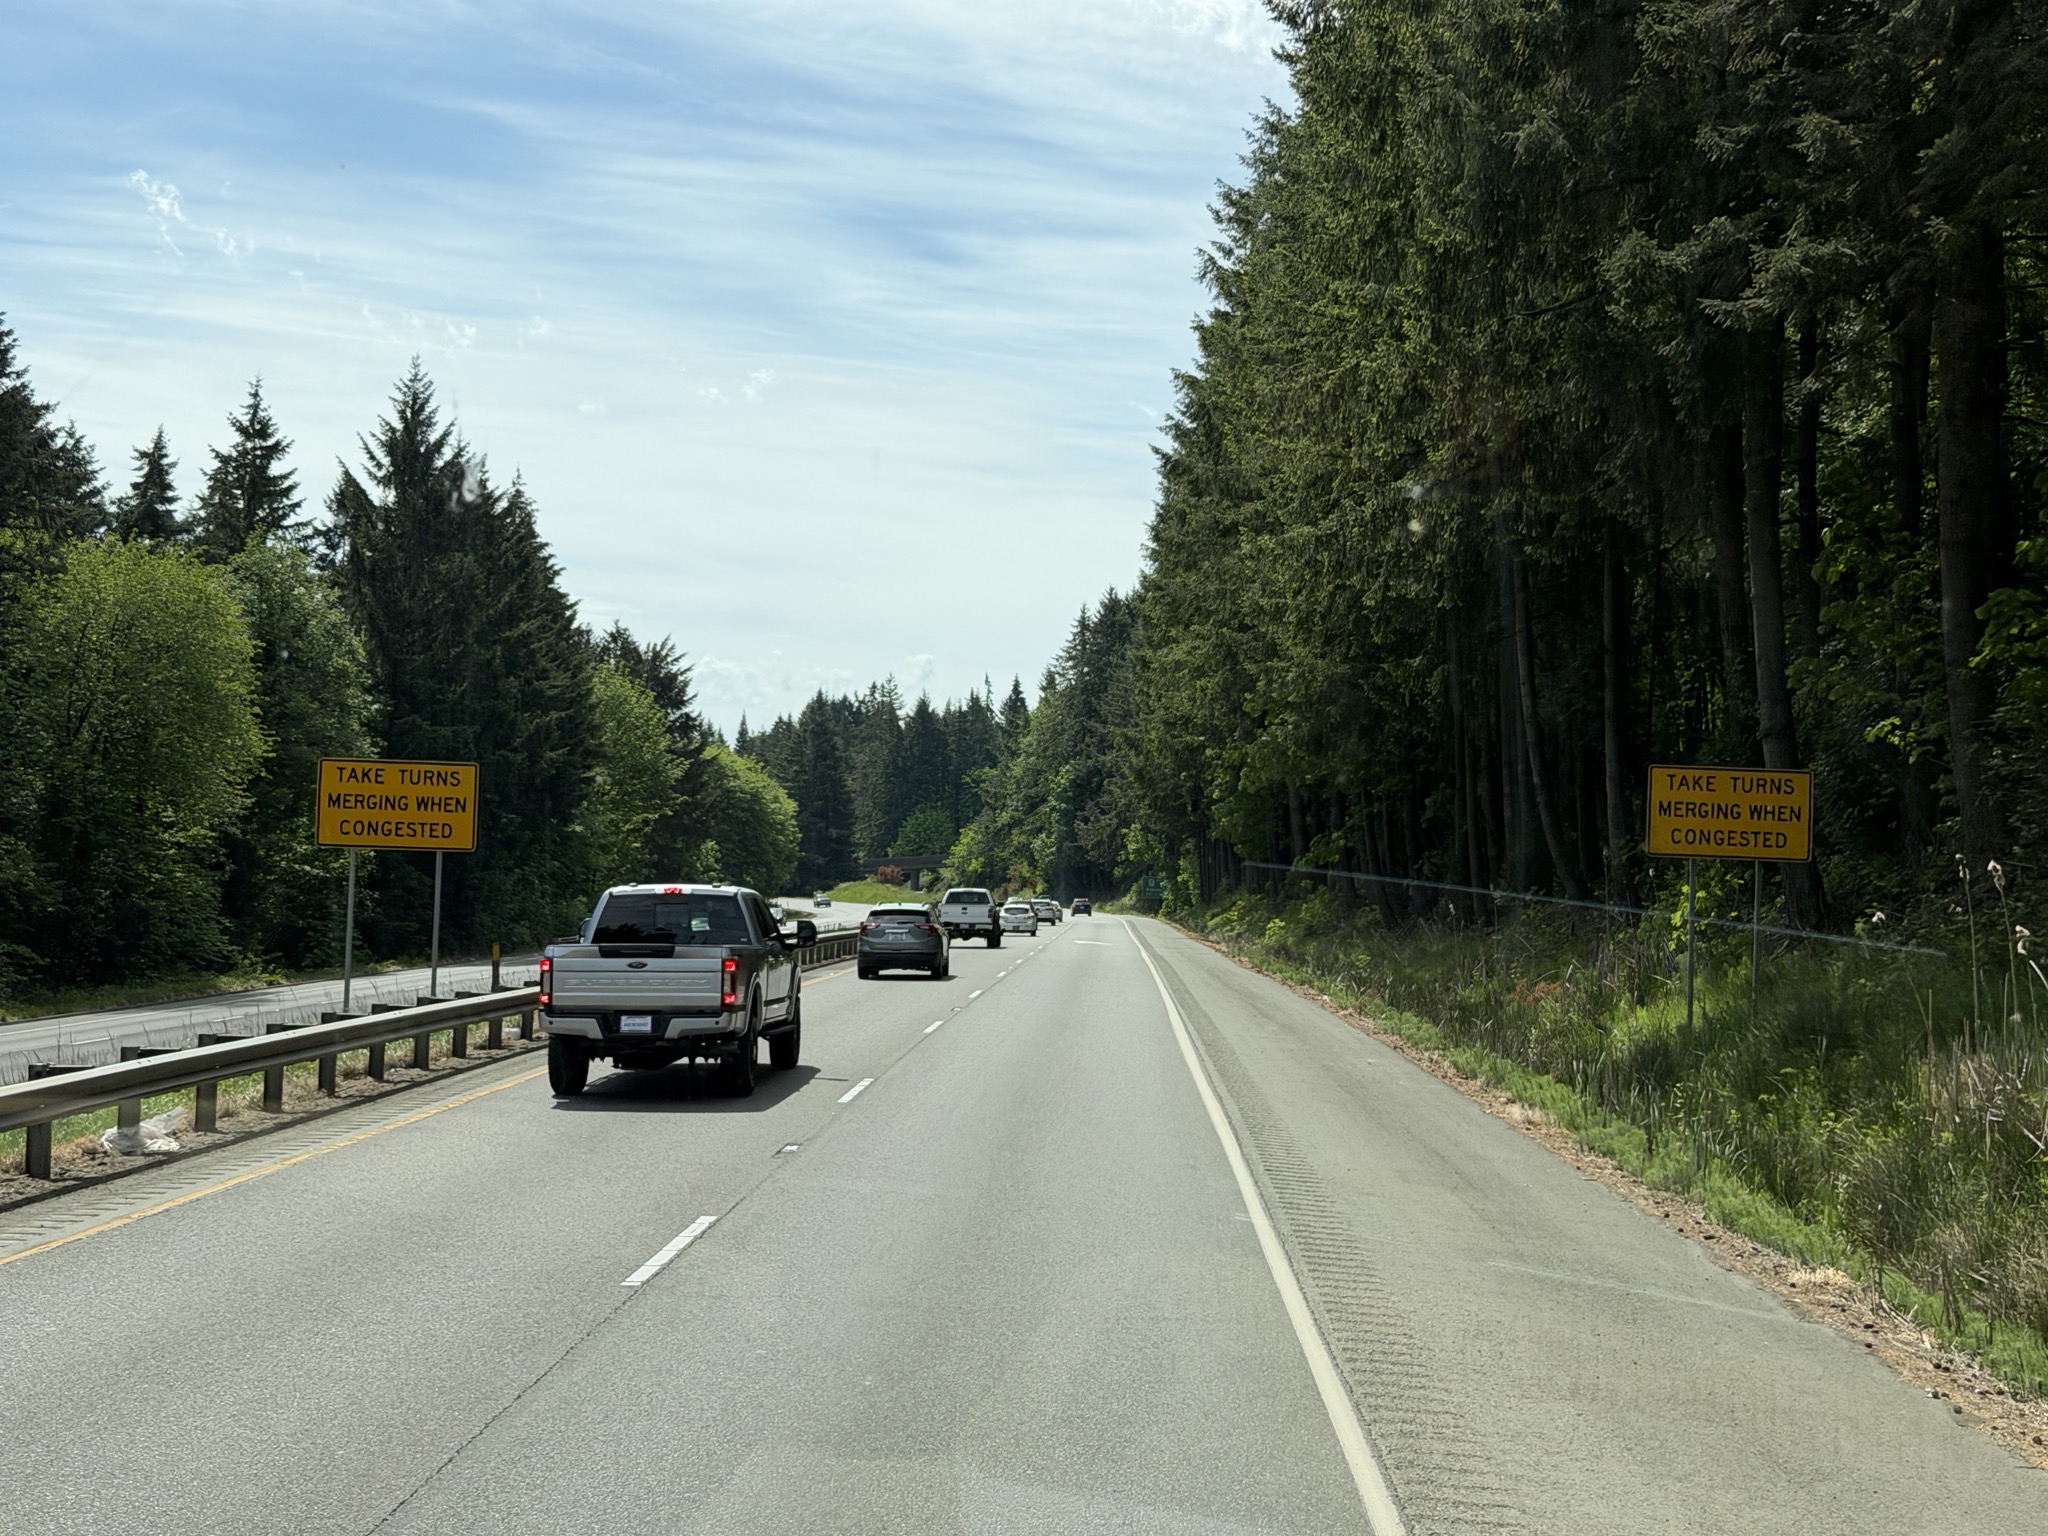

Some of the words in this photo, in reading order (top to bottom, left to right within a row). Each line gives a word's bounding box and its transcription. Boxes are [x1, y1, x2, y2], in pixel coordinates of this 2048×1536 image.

[336, 767, 385, 784] TAKE
[399, 769, 461, 787] TURNS
[1667, 774, 1716, 792] TAKE
[1730, 777, 1795, 795] TURNS
[328, 793, 408, 811] MERGING
[416, 796, 467, 813] WHEN
[1659, 800, 1741, 819] MERGING
[1749, 805, 1801, 822] WHEN
[340, 819, 452, 839] CONGESTED
[1671, 828, 1787, 849] CONGESTED
